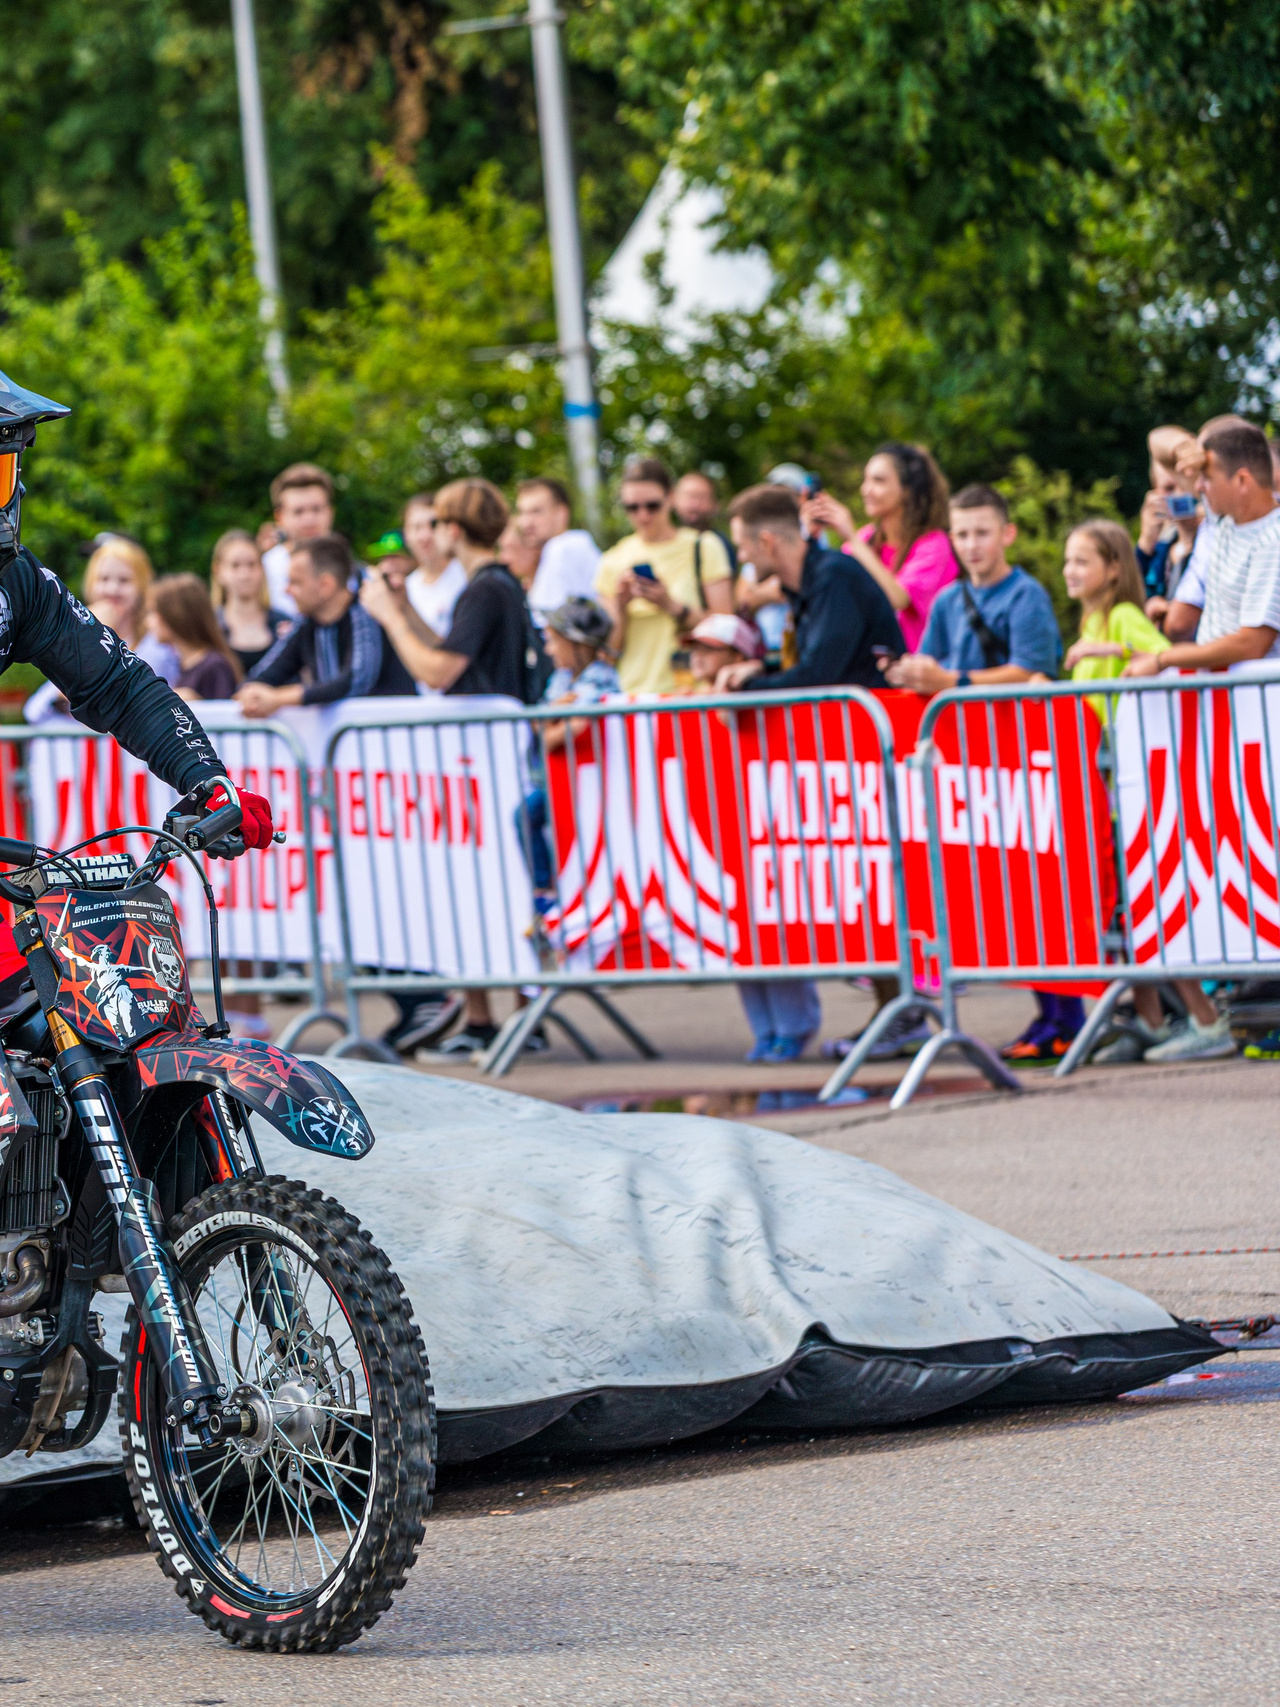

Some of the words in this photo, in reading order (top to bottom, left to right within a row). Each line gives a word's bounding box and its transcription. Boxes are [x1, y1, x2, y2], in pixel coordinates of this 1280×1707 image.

[751, 844, 894, 926] СПОРТ
[152, 913, 171, 924] NXM
[137, 999, 168, 1009] BULLET
[130, 1421, 194, 1576] DUNLOP
